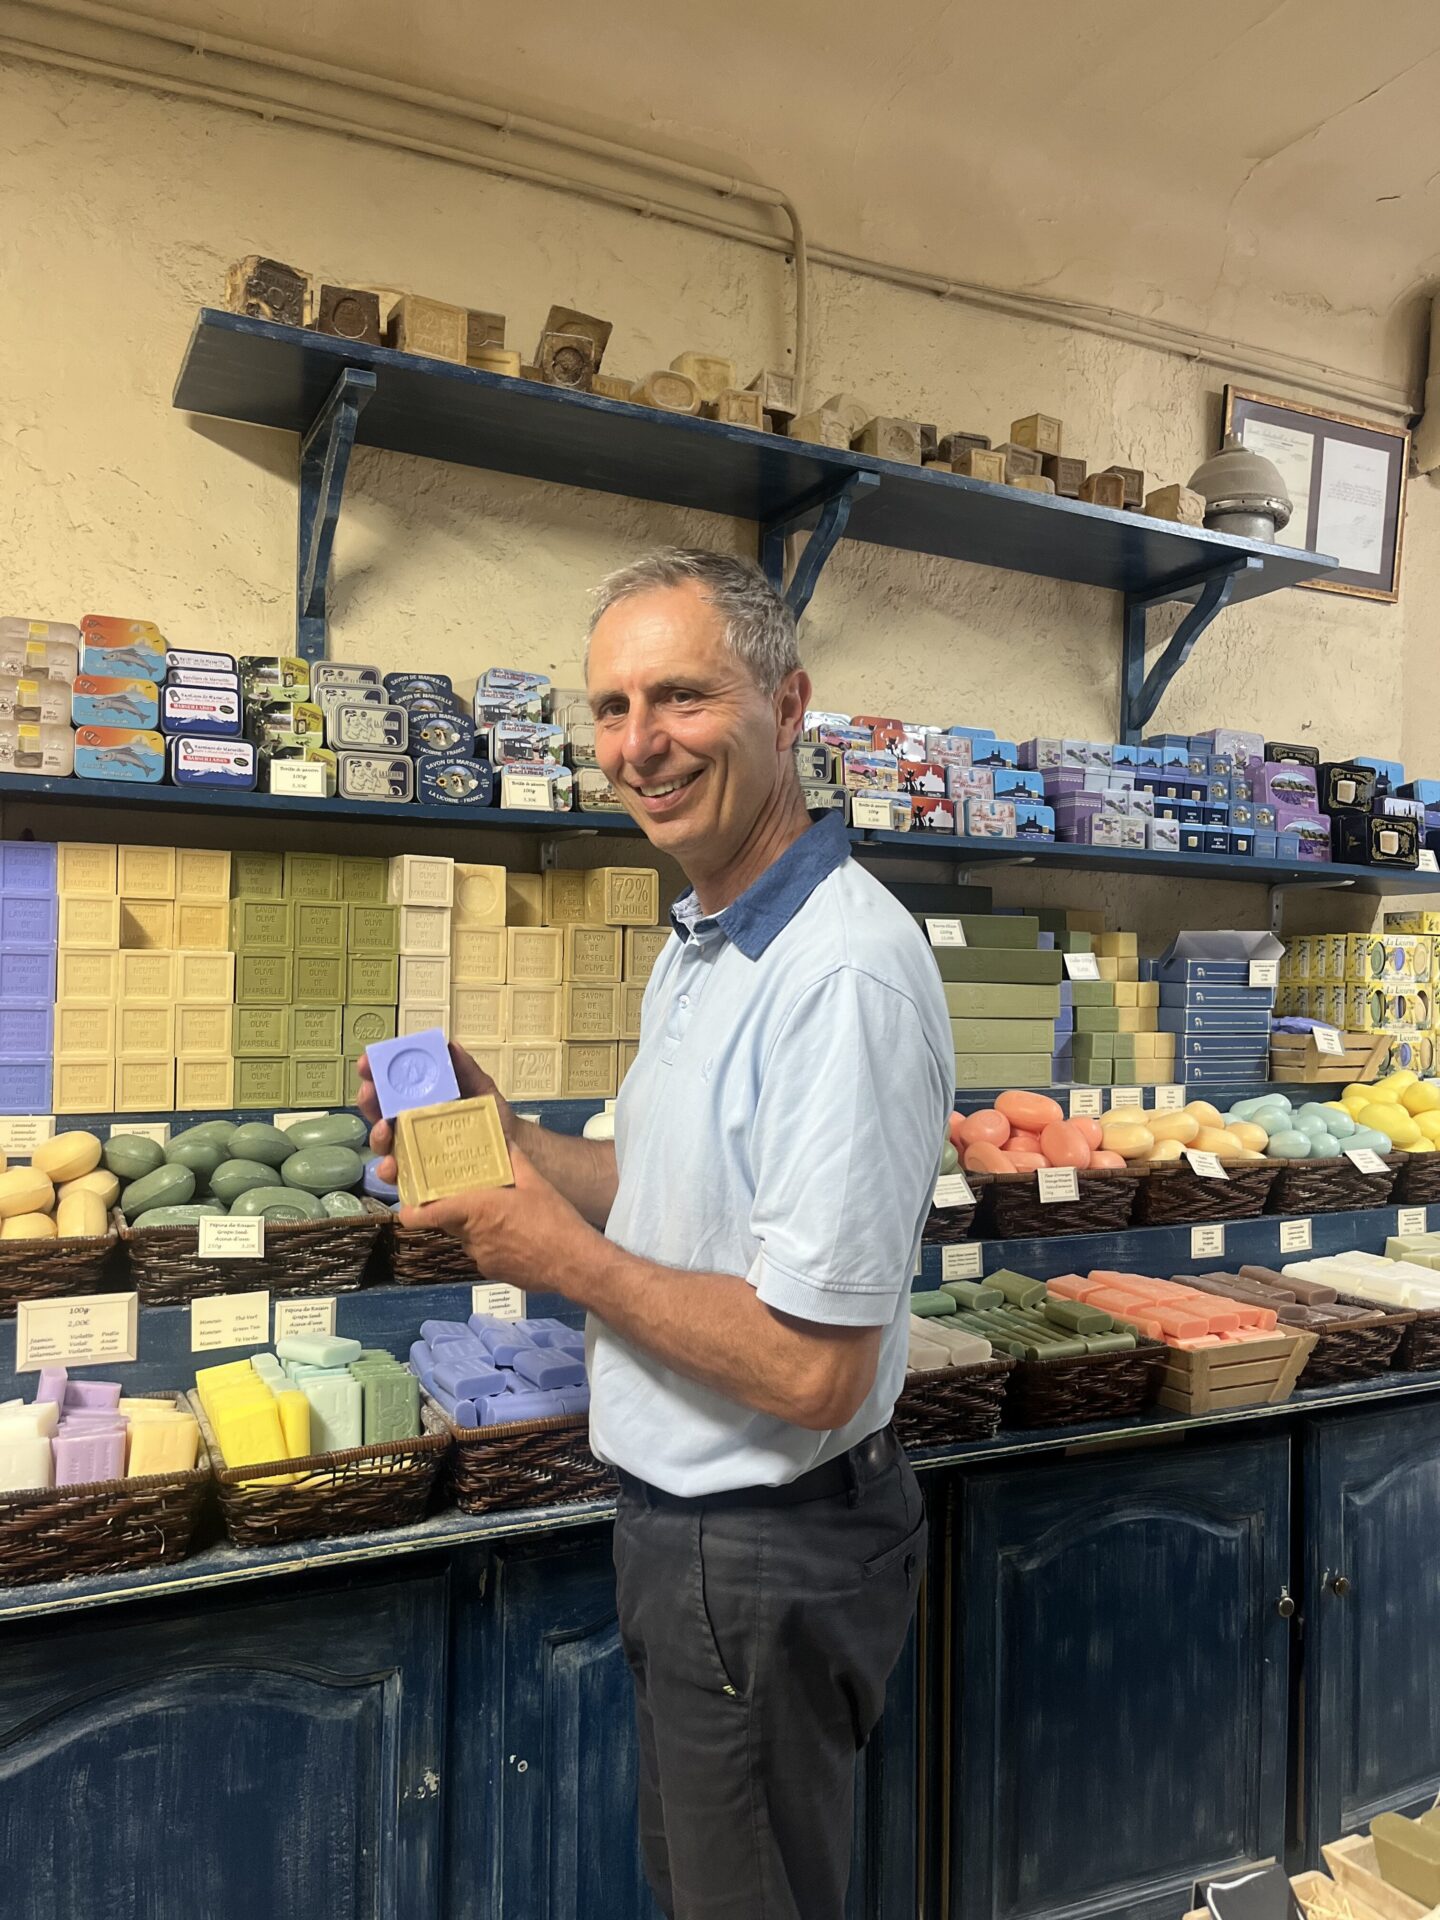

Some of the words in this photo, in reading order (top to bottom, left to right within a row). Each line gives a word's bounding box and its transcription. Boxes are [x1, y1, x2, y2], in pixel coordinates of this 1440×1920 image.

[391, 675, 409, 685] SAVON
[418, 675, 447, 688] MARSEILLE
[395, 693, 413, 704] SAVON
[422, 694, 453, 706] MARSEILLE
[411, 713, 429, 723] SAVON
[438, 713, 469, 727] MARSEILLE
[446, 746, 466, 756] FRANCE
[425, 758, 446, 769] SAVON
[456, 759, 488, 774] MARSEILLE
[428, 790, 436, 798] LA
[436, 794, 459, 804] LICORNE
[463, 793, 484, 803] FRANCE
[245, 867, 265, 875] OLIVE
[410, 890, 445, 898] MARSEILLE
[614, 878, 649, 903] 72%
[254, 906, 278, 915] SAVON
[310, 908, 331, 916] SAVON
[363, 910, 385, 919] SAVON
[614, 905, 649, 915] D'HUILE
[255, 915, 276, 923] OLIVE
[310, 917, 330, 926] OLIVE
[364, 919, 383, 927] OLIVE
[415, 921, 433, 930] OLIVE
[315, 927, 324, 935] DE
[245, 935, 285, 943] MARSEILLE
[300, 935, 339, 945] MARSEILLE
[355, 937, 392, 946] MARSEILLE
[466, 934, 490, 943] SAVON
[583, 934, 607, 942] SAVON
[641, 935, 662, 943] SAVON
[1395, 938, 1414, 947] Licorne
[252, 959, 276, 967] SAVON
[307, 959, 331, 968] SAVON
[457, 955, 497, 963] MARSEILLE
[360, 961, 383, 969] SAVON
[584, 964, 604, 972] OLIVE
[254, 967, 274, 976] OLIVE
[309, 968, 329, 977] OLIVE
[361, 969, 381, 978] OLIVE
[259, 978, 269, 986] DE
[314, 979, 323, 987] DE
[367, 979, 376, 987] DE
[244, 987, 283, 995] MARSEILLE
[299, 987, 337, 996] MARSEILLE
[352, 988, 389, 996] MARSEILLE
[1395, 986, 1415, 994] Licorne
[580, 992, 604, 1000] SAVON
[248, 1011, 272, 1019] SAVON
[304, 1011, 327, 1020] SAVON
[458, 1013, 497, 1021] MARSEILLE
[573, 1012, 612, 1020] MARSEILLE
[250, 1020, 270, 1028] OLIVE
[305, 1020, 324, 1028] OLIVE
[462, 1022, 491, 1032] NEUTRE
[255, 1030, 265, 1038] DE
[310, 1030, 319, 1038] DE
[355, 1026, 382, 1040] 72%
[240, 1039, 280, 1048] MARSEILLE
[295, 1039, 335, 1048] MARSEILLE
[250, 1063, 274, 1072] SAVON
[305, 1063, 328, 1071] SAVON
[517, 1052, 552, 1076] 72%
[251, 1072, 271, 1081] OLIVE
[306, 1071, 326, 1080] OLIVE
[256, 1082, 266, 1090] DE
[311, 1082, 321, 1090] DE
[516, 1080, 551, 1089] D'HUILE
[241, 1091, 280, 1100] MARSEILLE
[297, 1090, 335, 1099] MARSEILLE
[430, 1116, 472, 1132] SAVON
[446, 1134, 463, 1146] DE
[423, 1145, 494, 1169] MARSEILLE
[444, 1164, 480, 1178] OLIVE
[69, 1307, 90, 1315] 100g
[67, 1319, 90, 1328] 2,00€
